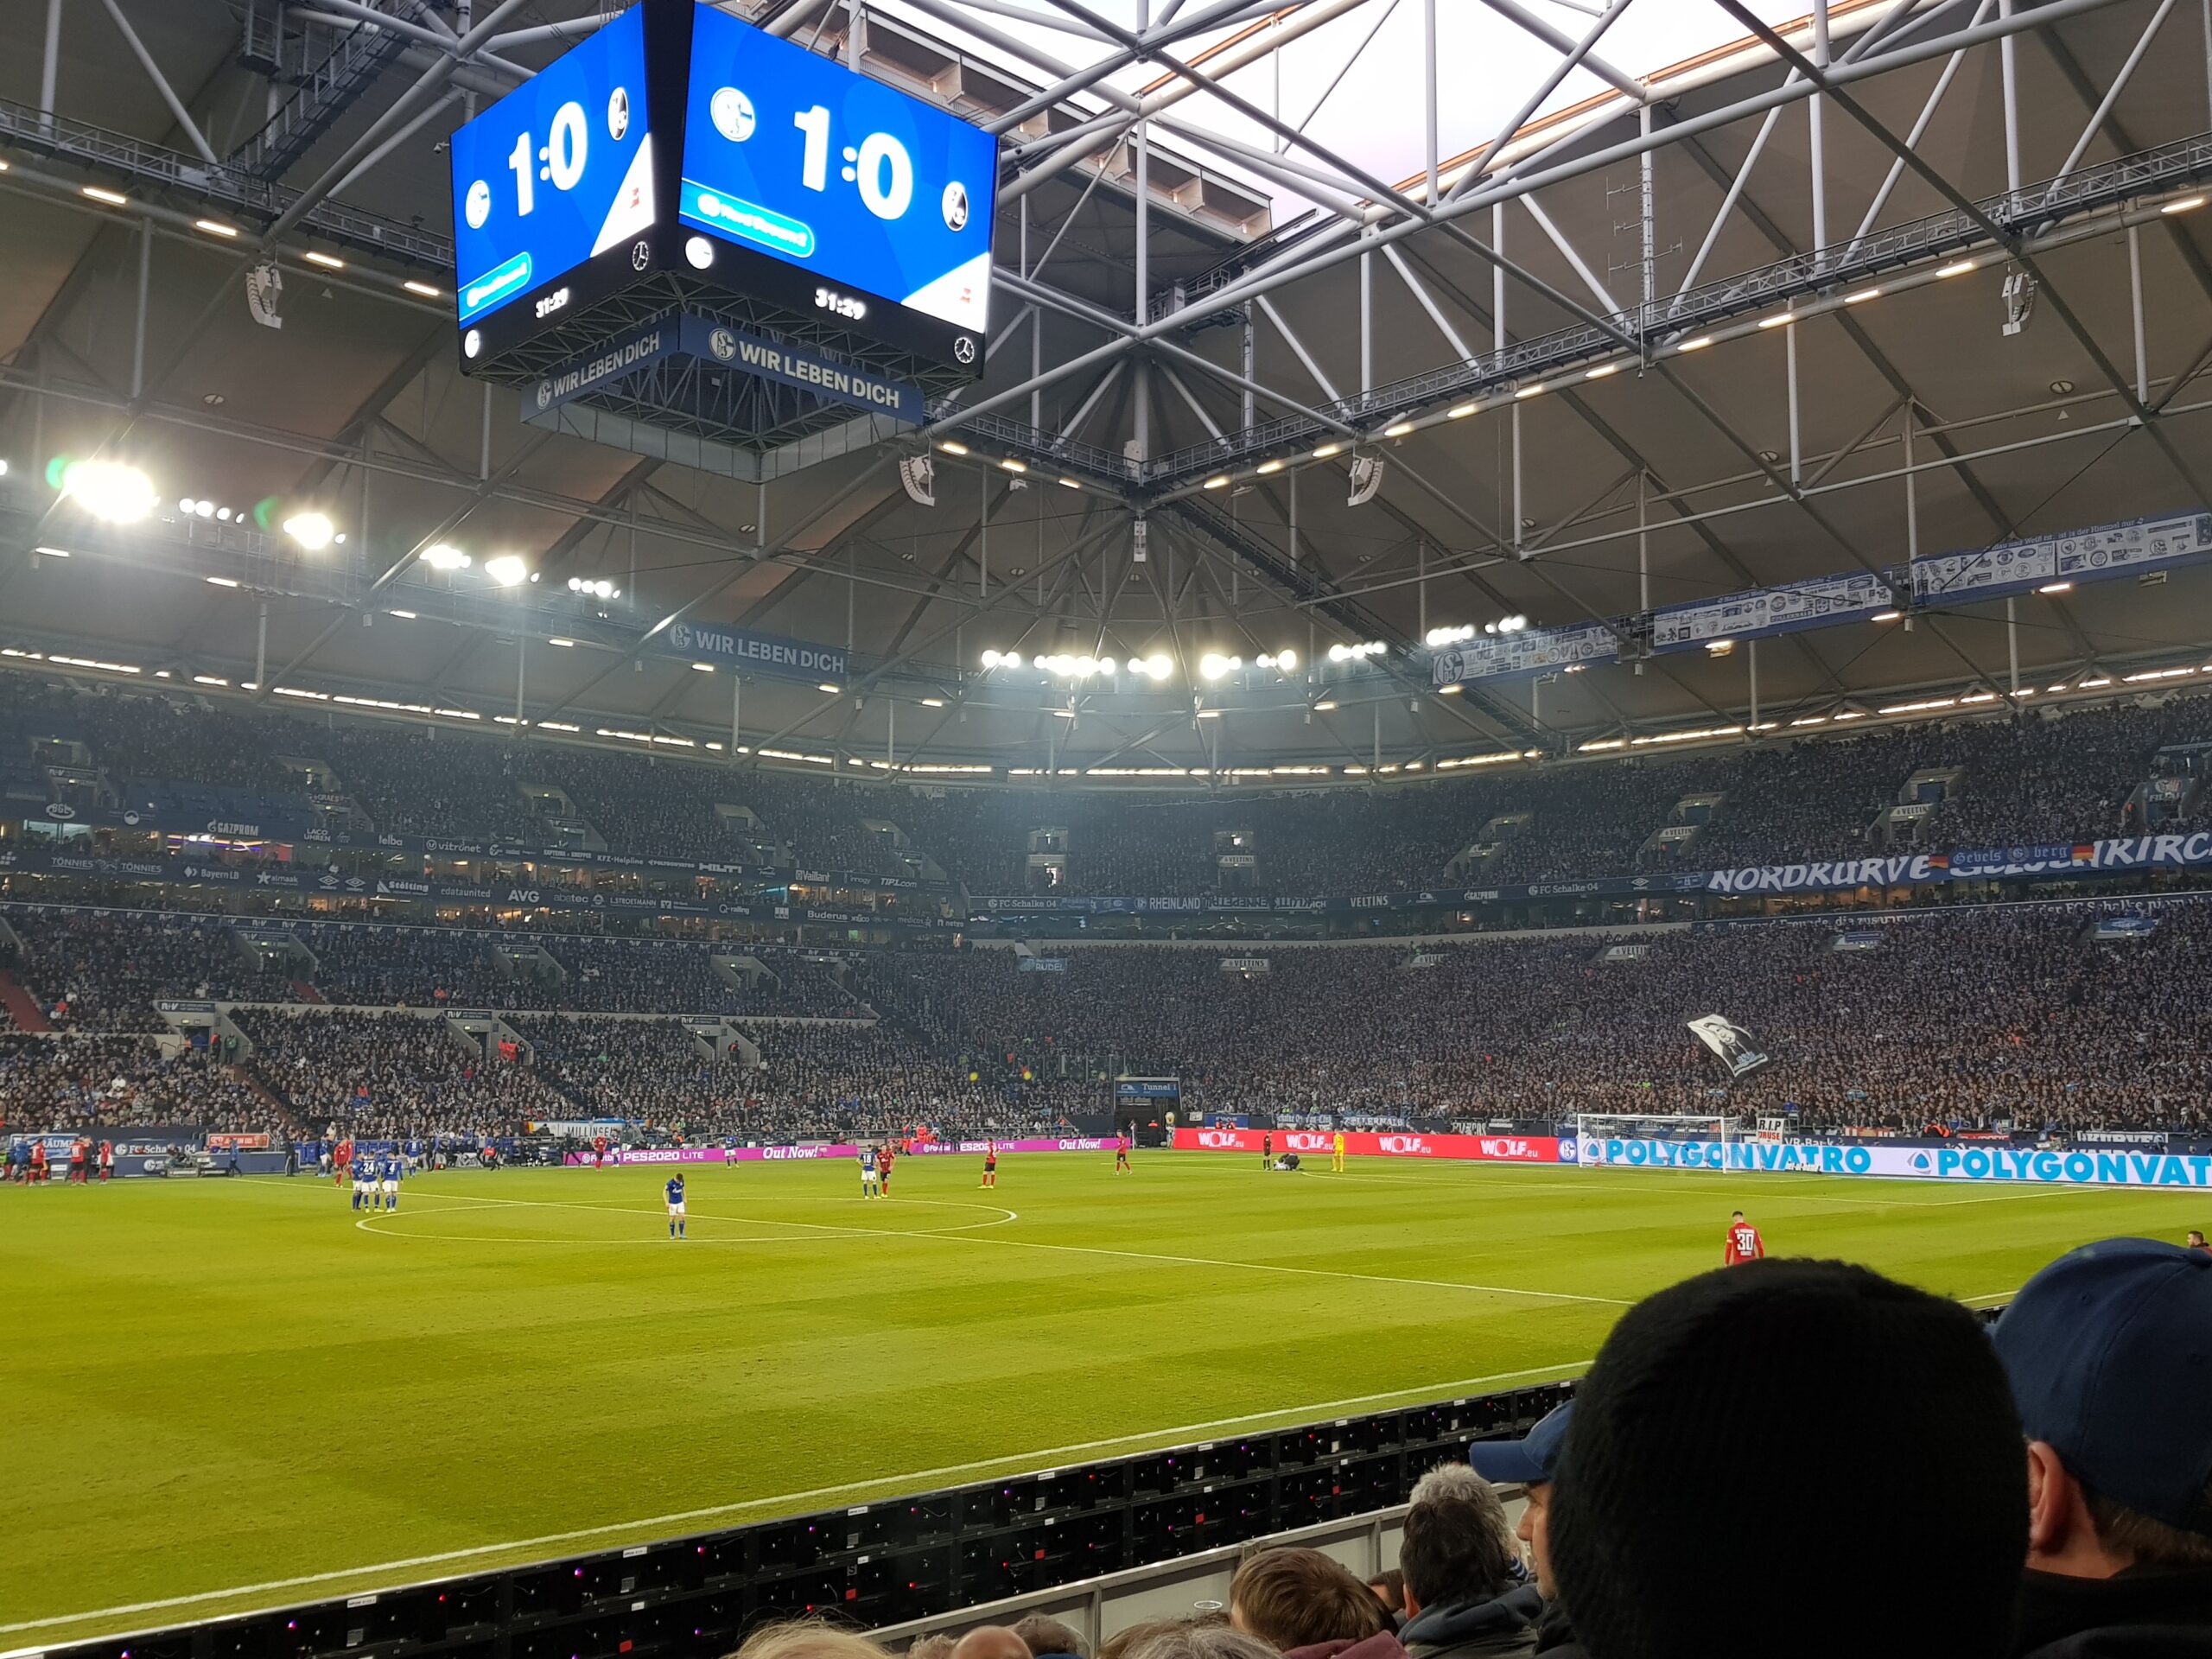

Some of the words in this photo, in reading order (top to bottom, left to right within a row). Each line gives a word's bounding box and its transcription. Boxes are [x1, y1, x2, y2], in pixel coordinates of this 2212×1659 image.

[509, 101, 588, 217] 1:0
[794, 105, 913, 219] 1:0
[815, 289, 866, 321] 31:29
[553, 372, 579, 397] WIR
[581, 349, 623, 386] LEBEN
[625, 331, 660, 365] DICH
[739, 340, 781, 372] WIR
[784, 356, 849, 394] LEBEN
[852, 378, 899, 410] DICH
[696, 630, 734, 654] WIR
[737, 639, 797, 665] LEBEN
[800, 651, 844, 673] DICH
[218, 823, 259, 836] GAZPROM
[378, 835, 403, 846] telba
[51, 856, 94, 868] TÖNNIES
[122, 862, 162, 873] TÖNNIES
[699, 862, 742, 874] HILTI
[803, 870, 830, 882] Vaillant
[1707, 855, 1932, 893] NORDKURVE
[1553, 883, 1586, 894] Schalke
[1586, 882, 1599, 892] 04
[508, 890, 540, 903] AVG
[1350, 895, 1389, 907] VELTINS
[1011, 899, 1045, 908] Schalke
[1046, 899, 1057, 908] 04
[1149, 897, 1201, 910] RHEINLAND
[807, 910, 848, 920] Buderus
[1035, 963, 1065, 971] RUDEL
[1058, 1140, 1076, 1150] Out
[1077, 1138, 1102, 1150] Now!
[1198, 1131, 1244, 1147] WOLF.eu
[1286, 1133, 1333, 1151] WOLF.eu
[1379, 1135, 1432, 1154] WOLF.eu
[184, 1143, 196, 1154] 04
[763, 1147, 785, 1159] Out
[787, 1145, 818, 1159] Now!
[1480, 1138, 1539, 1158] WOLF.eu
[623, 1151, 681, 1162] PES2020
[683, 1151, 704, 1160] LITE
[863, 1154, 871, 1164] 18
[1607, 1139, 1872, 1174] POLYGONVATRO
[363, 1161, 375, 1173] 24
[389, 1161, 395, 1173] 4
[1737, 1233, 1754, 1251] 30
